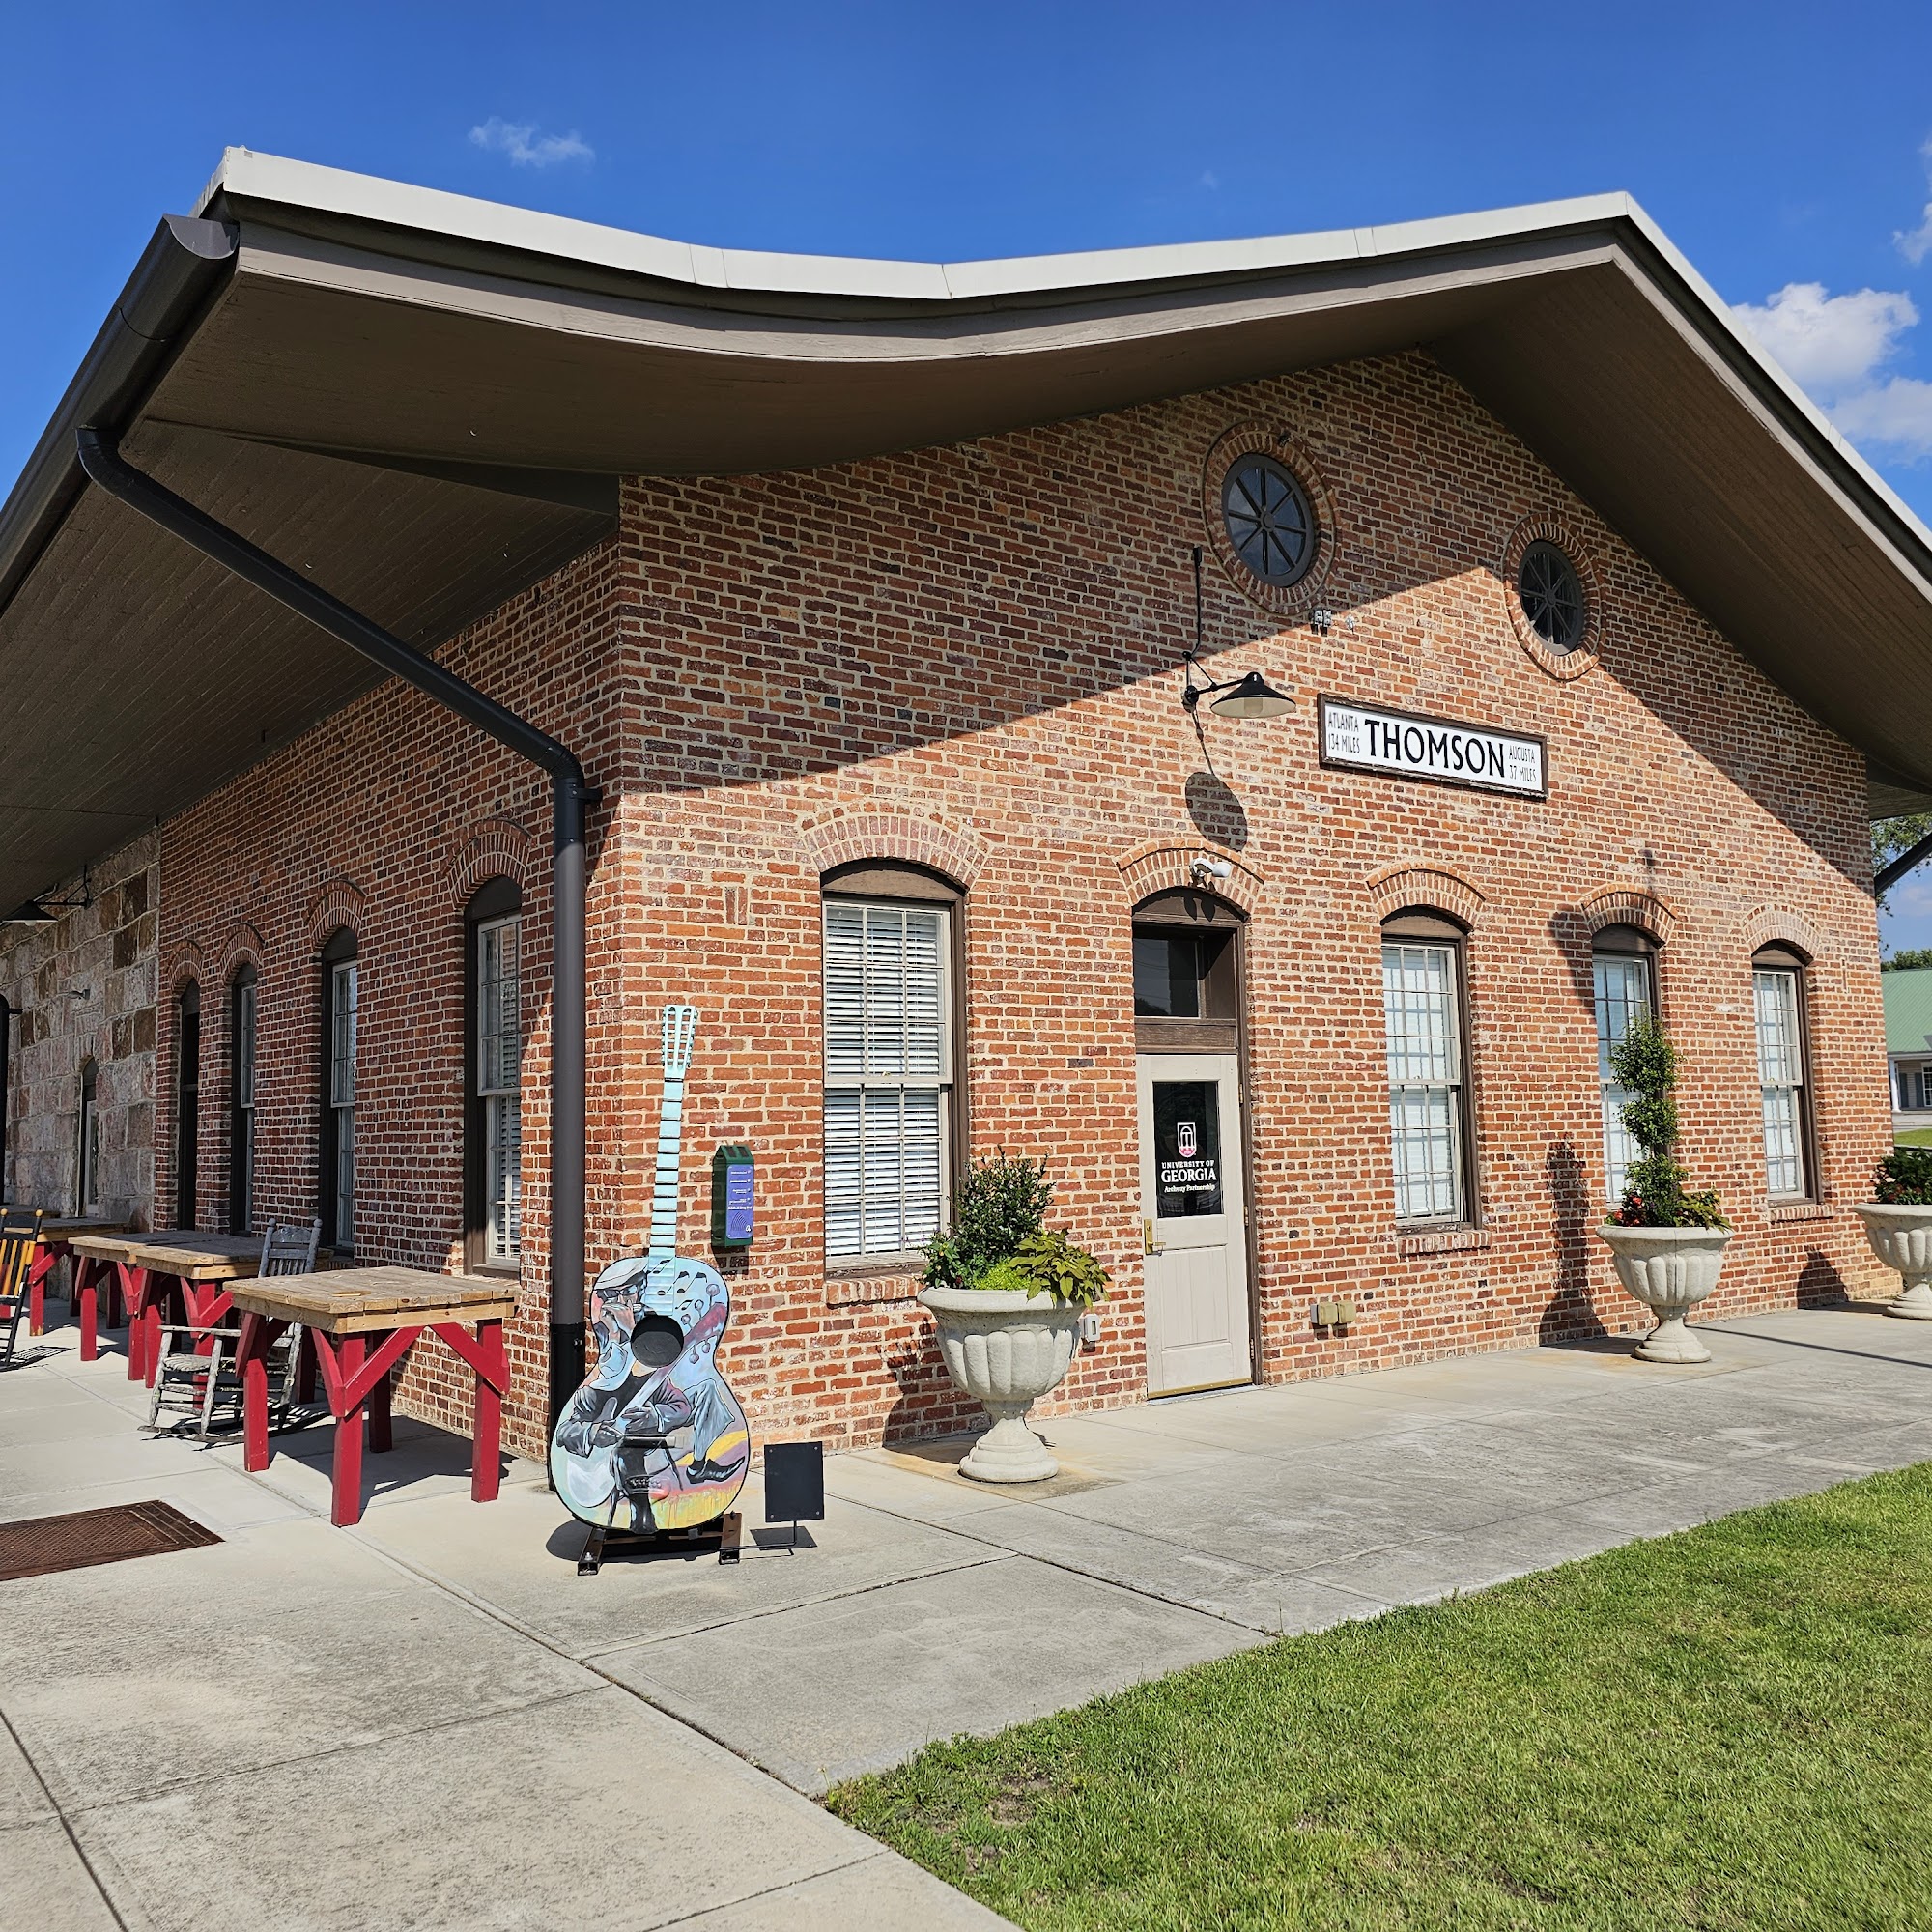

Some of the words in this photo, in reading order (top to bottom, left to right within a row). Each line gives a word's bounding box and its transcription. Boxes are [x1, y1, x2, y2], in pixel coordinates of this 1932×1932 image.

[1328, 711, 1359, 732] ATLANTA
[1328, 733, 1339, 751] 134
[1341, 735, 1360, 753] MILES
[1364, 719, 1505, 778] THOMSON
[1508, 745, 1535, 763] AUGUSTA
[1519, 766, 1536, 782] MILES
[1161, 1168, 1217, 1182] GEORGIA
